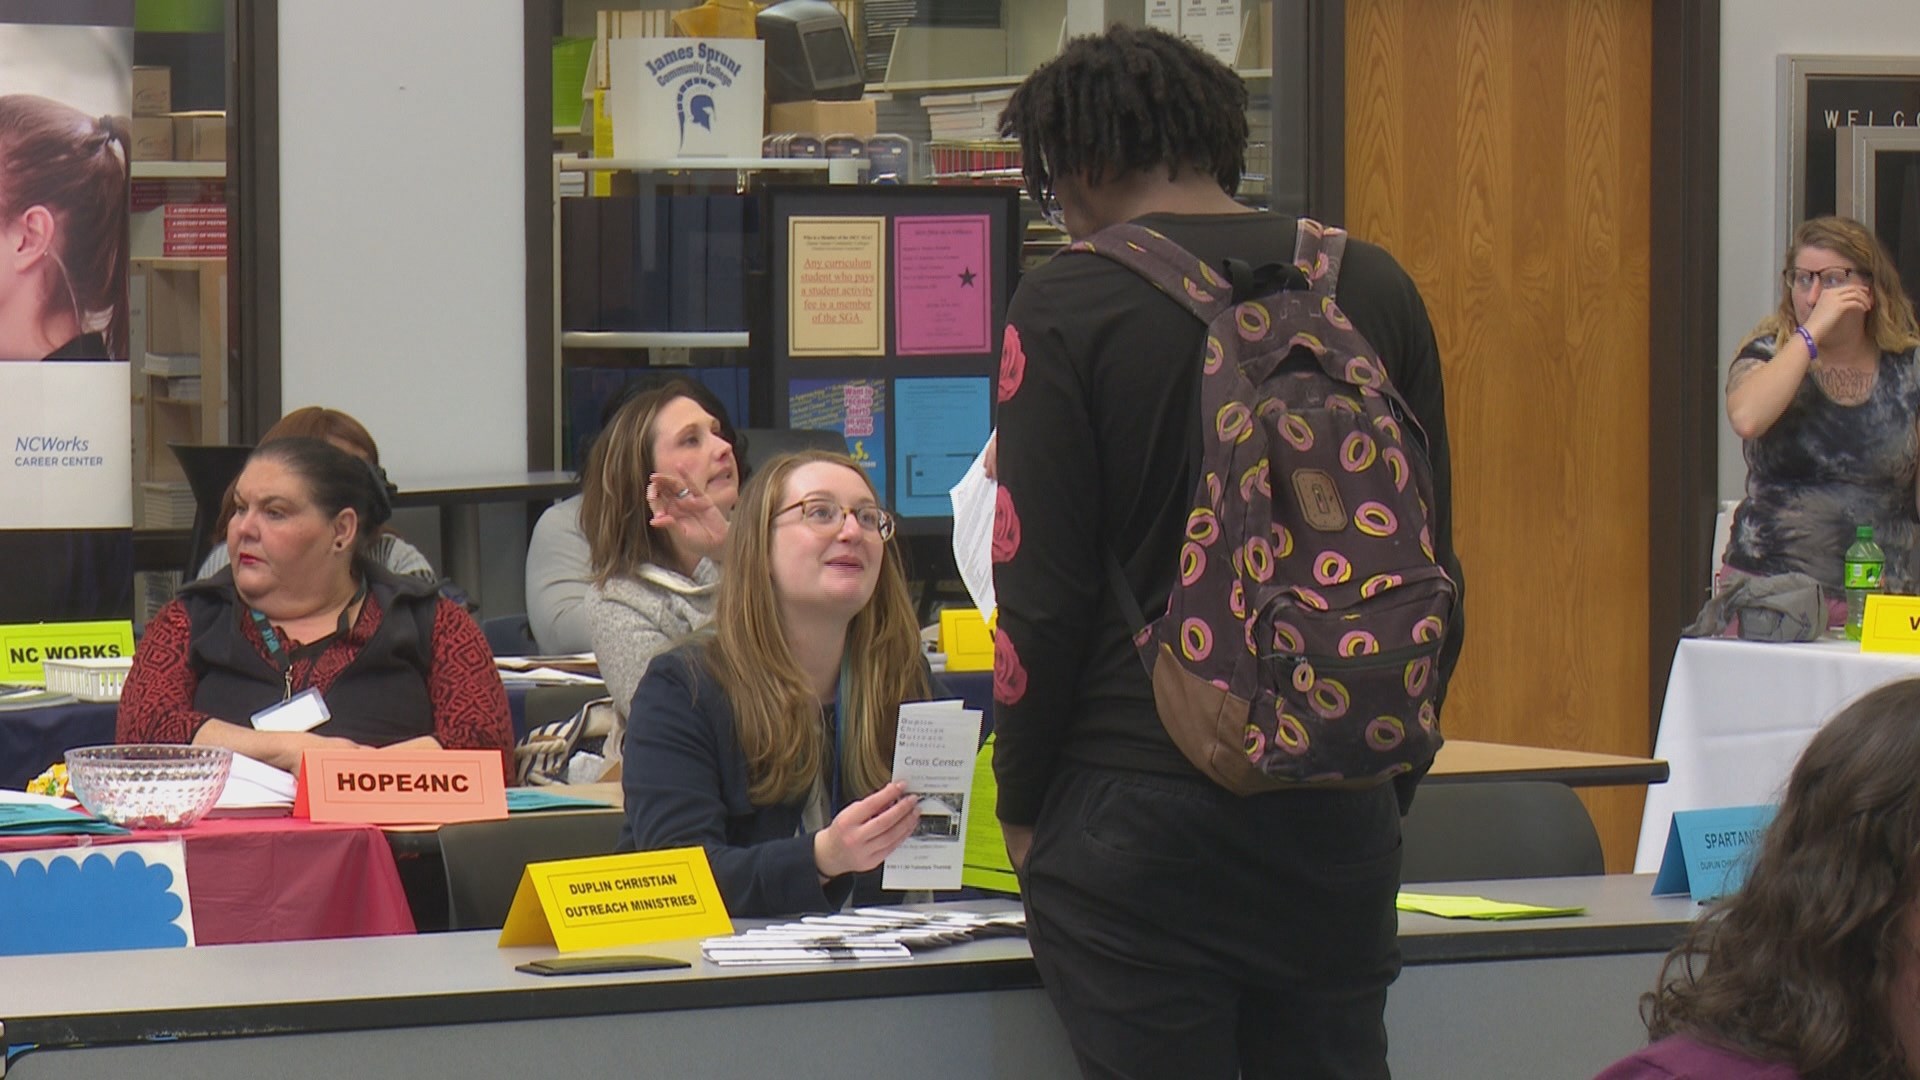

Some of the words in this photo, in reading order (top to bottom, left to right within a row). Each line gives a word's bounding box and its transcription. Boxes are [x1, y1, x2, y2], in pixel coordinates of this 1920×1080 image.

[645, 46, 694, 76] James
[698, 42, 742, 77] Sprunt
[656, 62, 704, 87] Community
[706, 62, 733, 87] College
[804, 258, 822, 270] Any
[825, 258, 872, 269] curriculum
[800, 272, 831, 282] student
[834, 272, 852, 282] who
[854, 274, 874, 284] pays
[808, 286, 839, 296] student
[842, 286, 873, 298] activity
[804, 299, 818, 310] fee
[820, 300, 827, 310] is
[836, 300, 872, 310] member
[812, 312, 823, 324] of
[824, 312, 837, 324] the
[839, 312, 863, 324] SGA.
[845, 388, 863, 396] Want
[864, 388, 872, 396] to
[845, 398, 872, 406] receive
[848, 407, 870, 416] alerts
[856, 418, 872, 426] your
[846, 426, 872, 435] phone?
[15, 436, 90, 452] NCWorks
[14, 456, 58, 466] CAREER
[62, 456, 103, 466] CENTER
[10, 647, 39, 664] NC
[44, 644, 121, 660] WORKS
[904, 756, 930, 766] Crisis
[932, 756, 964, 767] Center
[336, 772, 470, 792] HOPE4NC
[568, 880, 612, 895] DUPLIN
[614, 874, 678, 891] CHRISTIAN
[565, 902, 629, 918] OUTREACH
[631, 894, 697, 912] MINISTRIES
